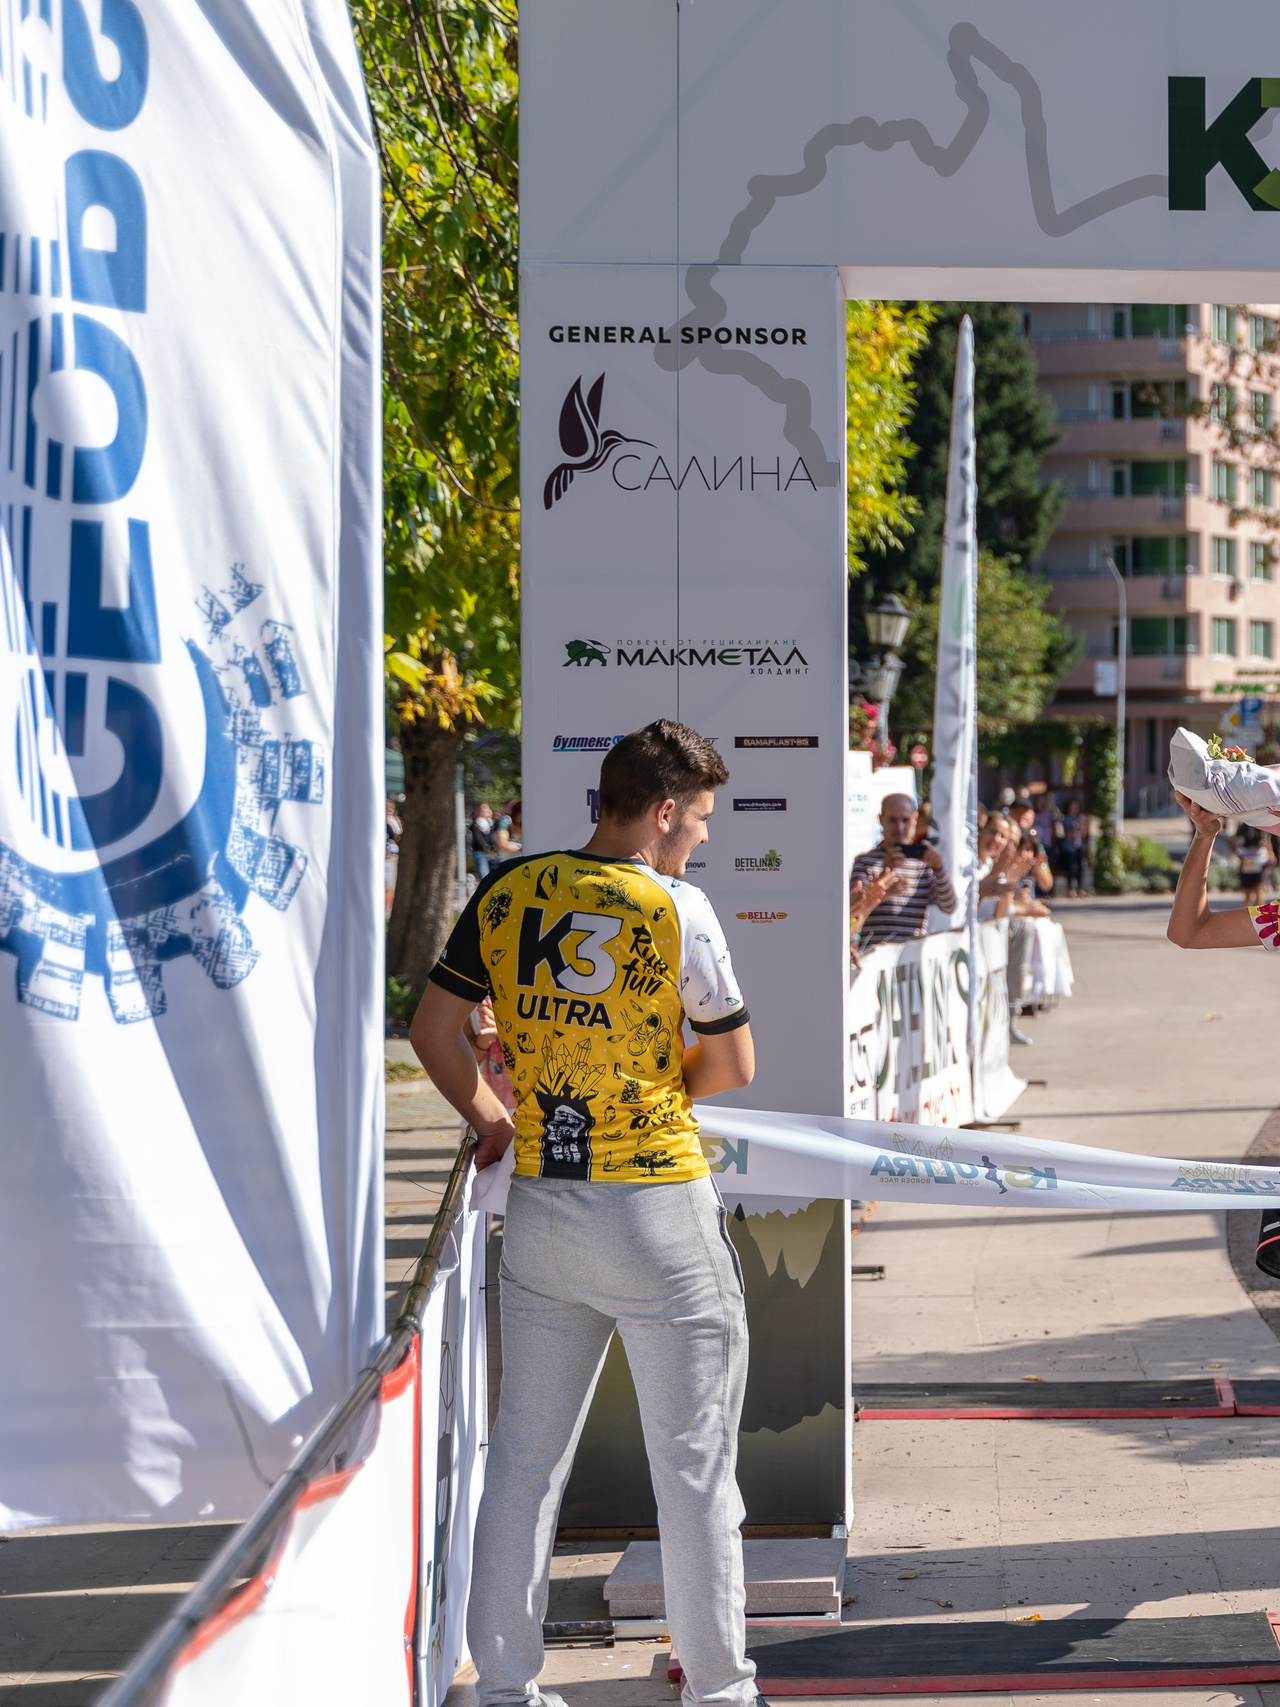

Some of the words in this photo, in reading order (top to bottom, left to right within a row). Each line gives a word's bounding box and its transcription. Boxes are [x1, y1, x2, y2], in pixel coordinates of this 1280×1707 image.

[548, 325, 672, 344] GENERAL
[680, 327, 808, 345] SPONSOR
[612, 454, 818, 491] САЛИНА
[703, 639, 798, 647] РЕЦИКЛИРАНЕ
[616, 646, 809, 667] МАКМЕТАЛ
[750, 668, 809, 676] ХОЛДИНГ
[735, 857, 781, 868] DETELINA'S
[517, 906, 624, 996] K3
[619, 958, 665, 997] fun
[516, 992, 613, 1030] ULTRA
